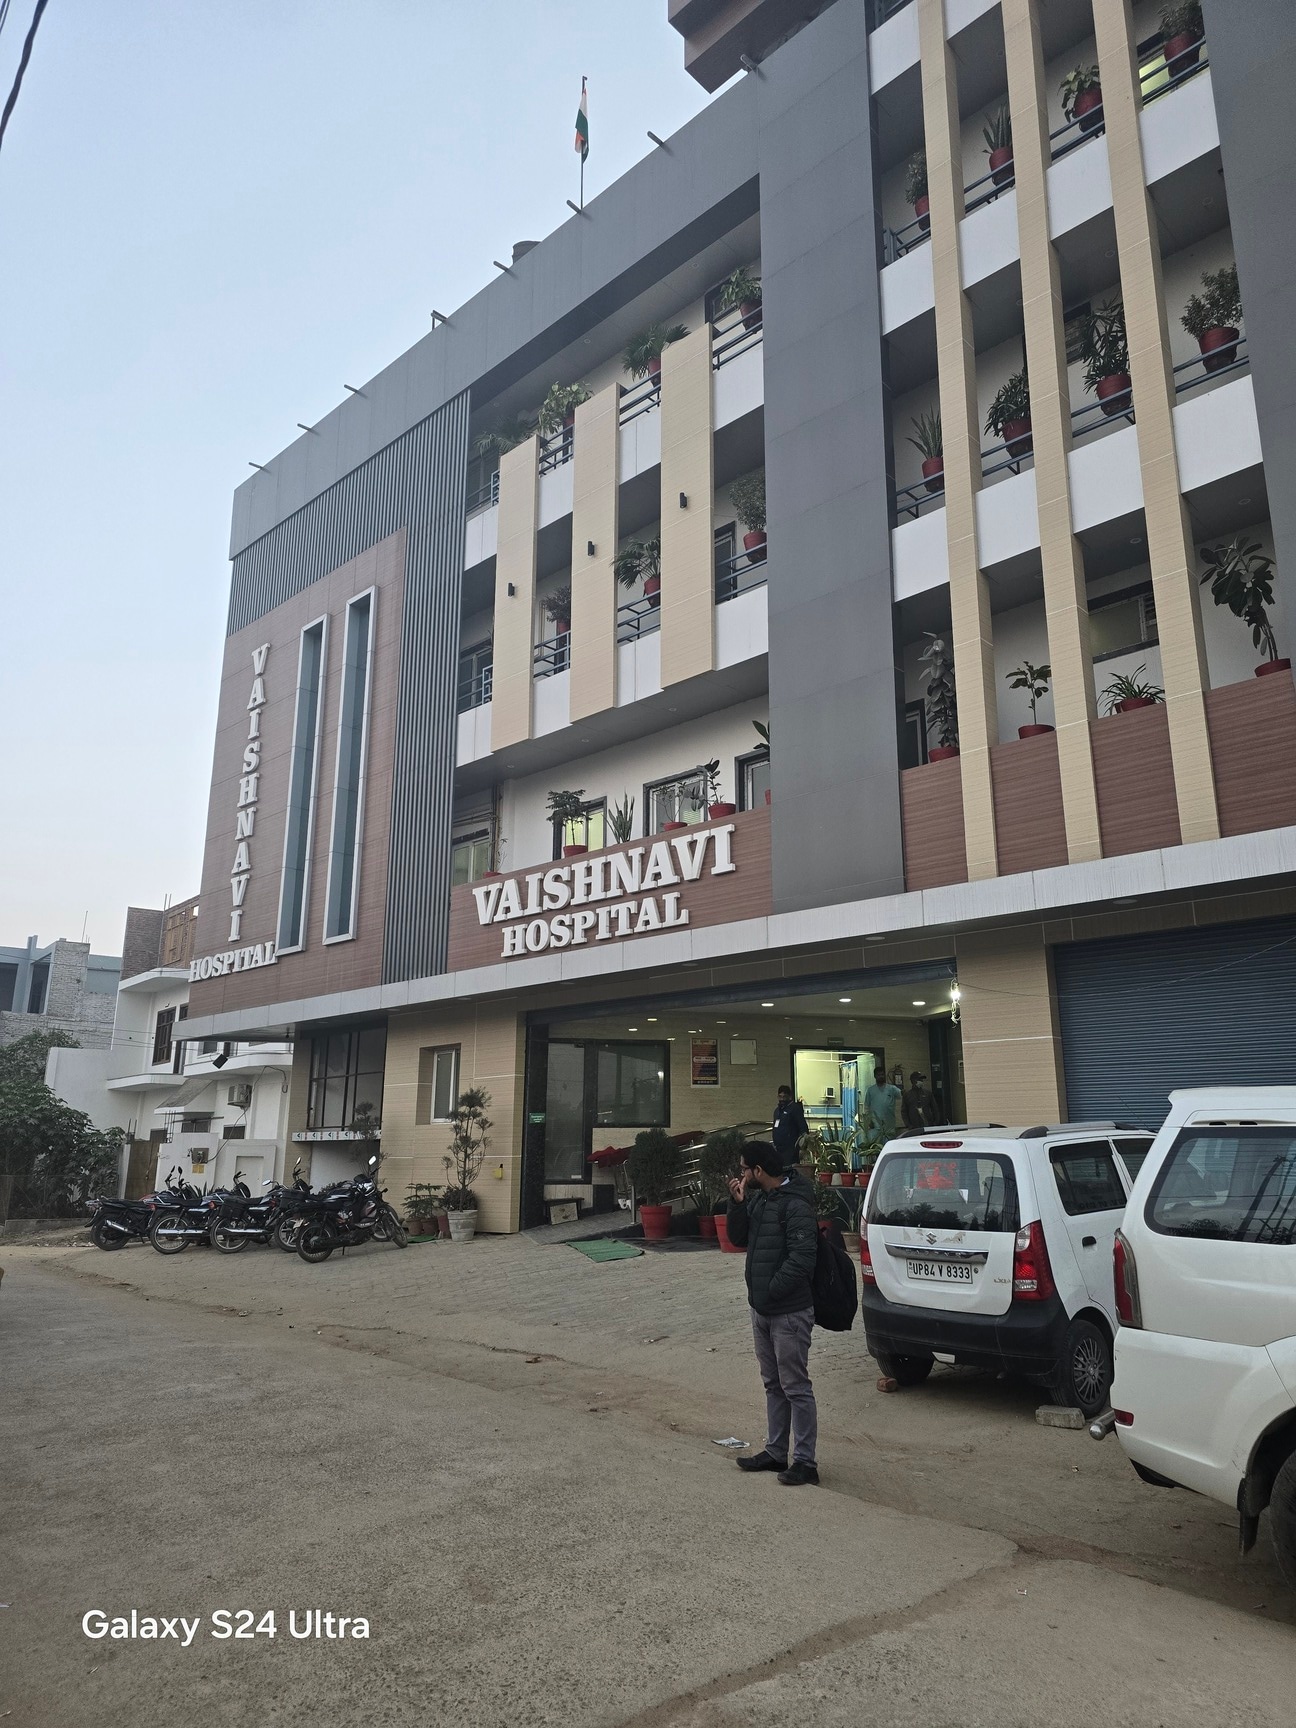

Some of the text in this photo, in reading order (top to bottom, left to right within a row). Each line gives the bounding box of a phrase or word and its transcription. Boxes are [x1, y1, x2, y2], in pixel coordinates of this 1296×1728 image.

[228, 642, 272, 942] VAISHNAVI
[472, 823, 736, 925] VAISHNAVI
[500, 891, 690, 958] HOSPITAL
[187, 940, 279, 983] HOSPITAL
[912, 1262, 970, 1279] UP84 V 8333
